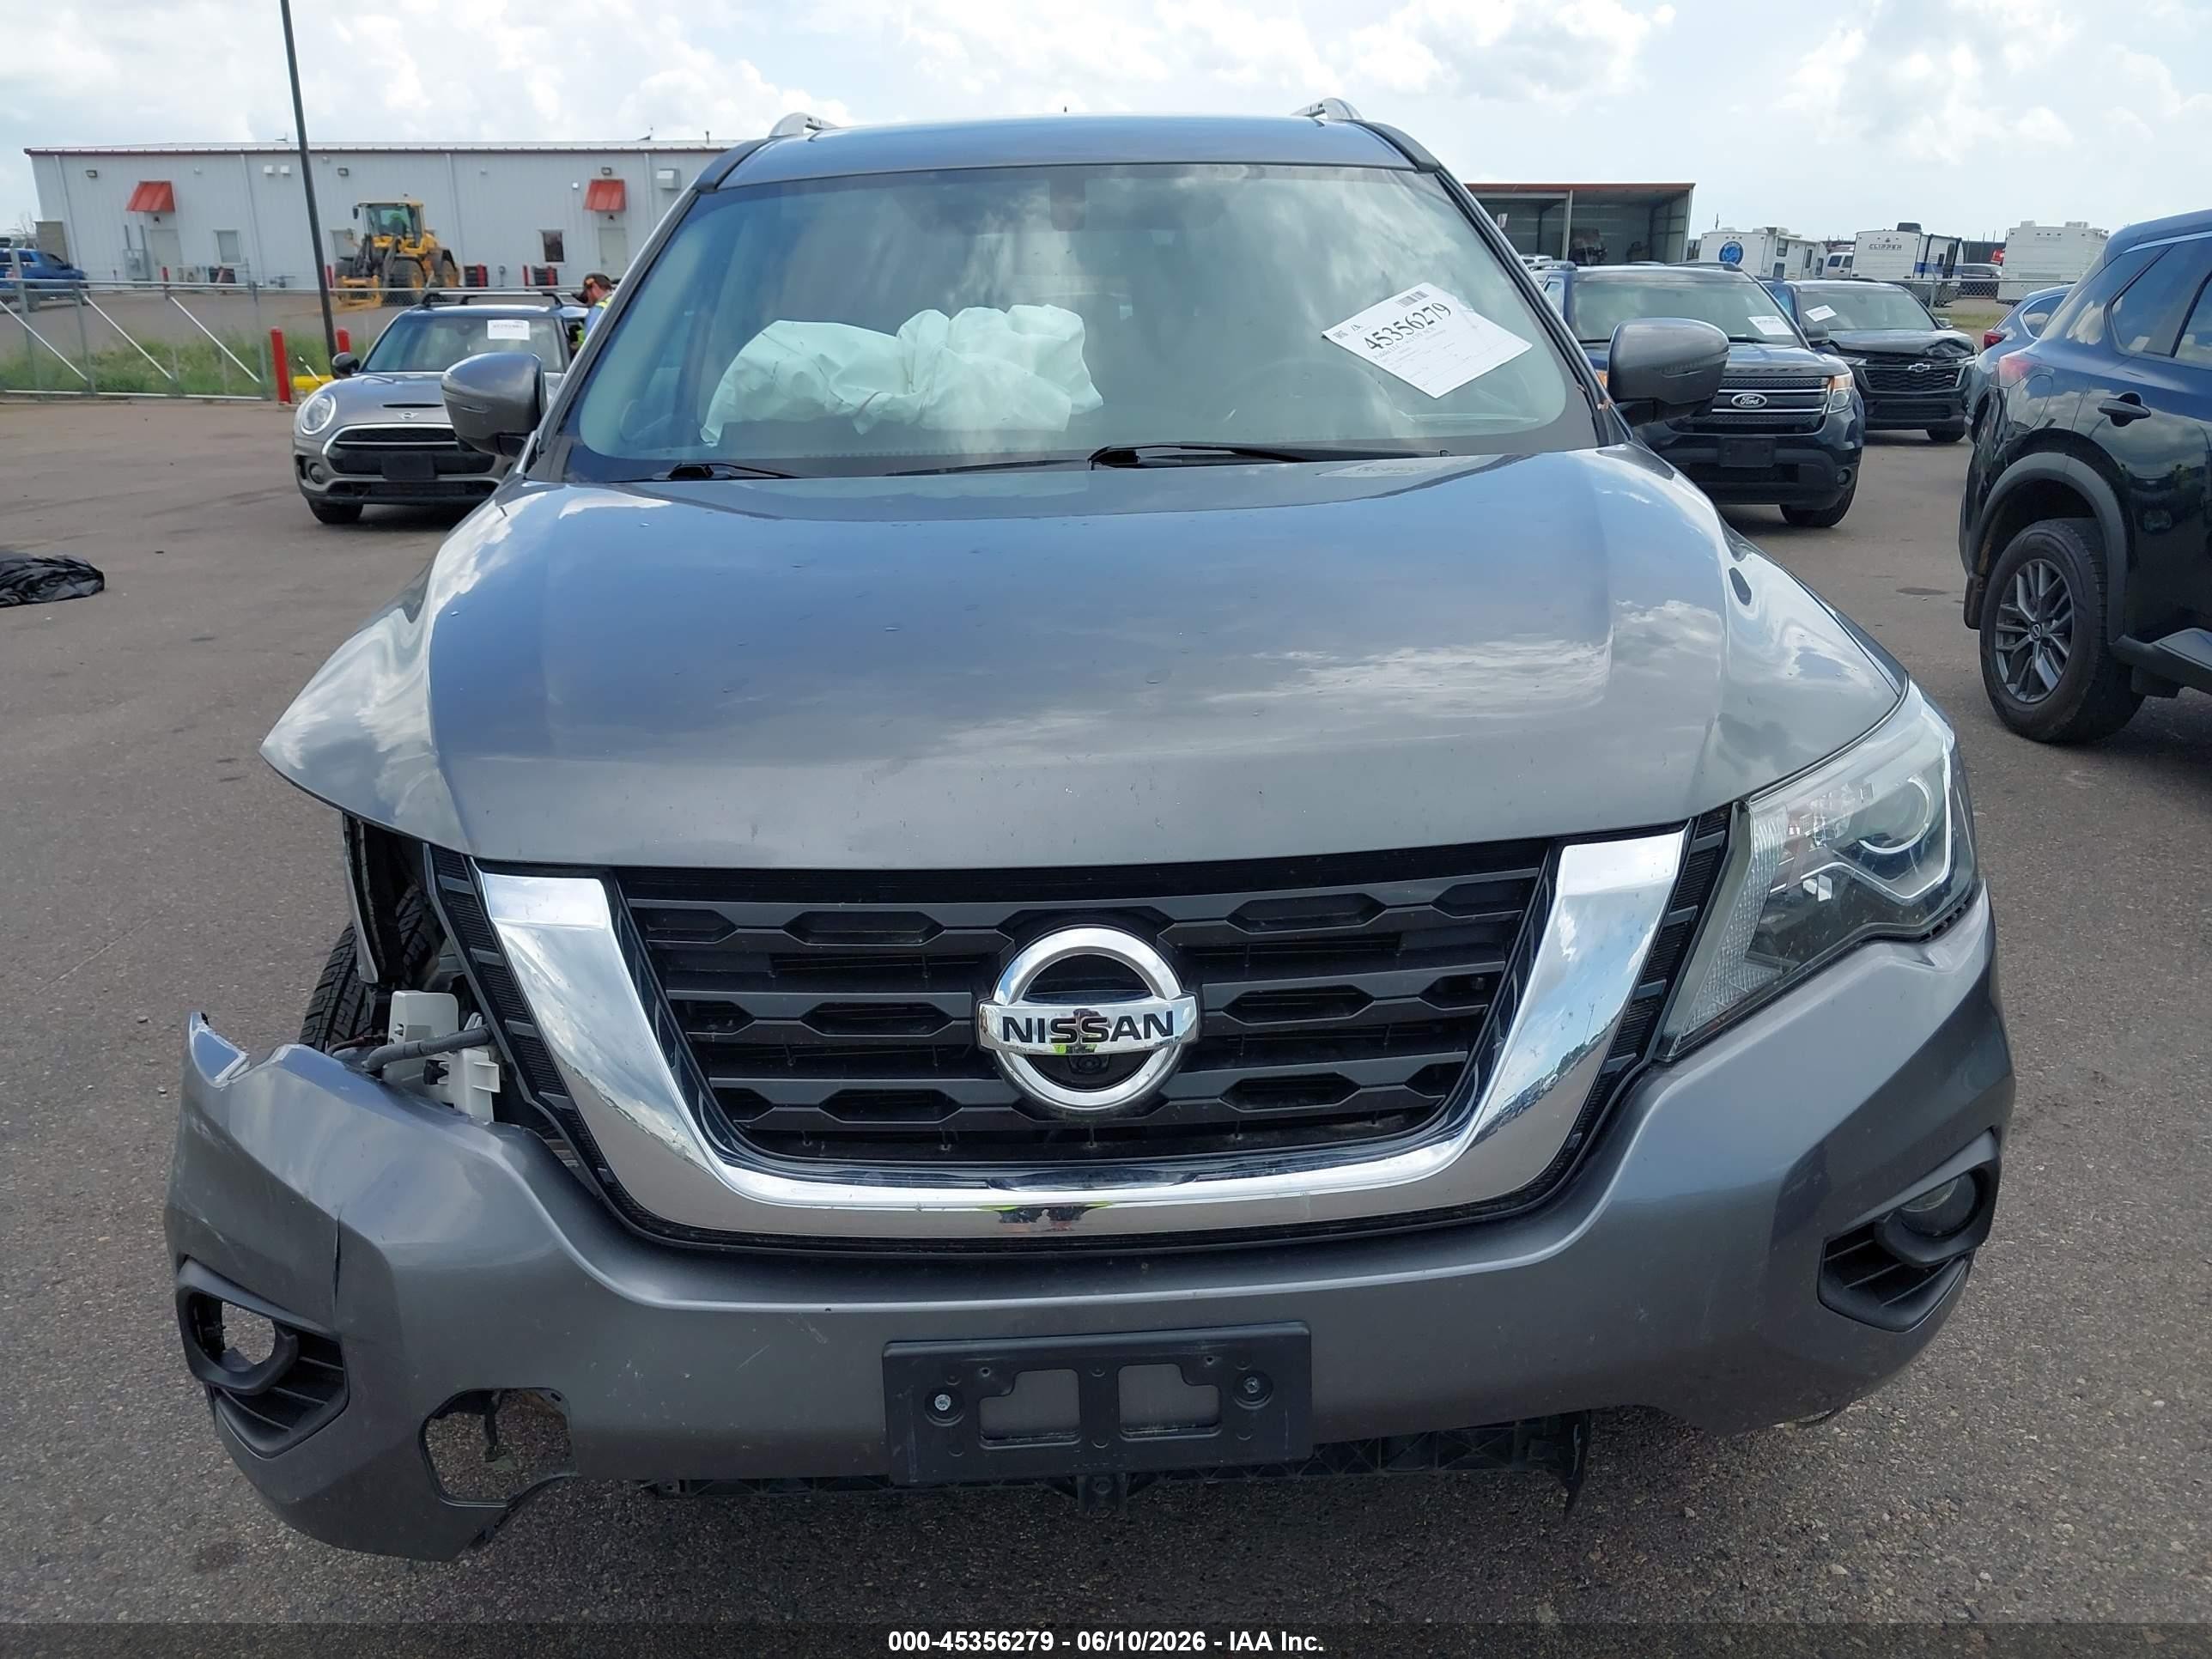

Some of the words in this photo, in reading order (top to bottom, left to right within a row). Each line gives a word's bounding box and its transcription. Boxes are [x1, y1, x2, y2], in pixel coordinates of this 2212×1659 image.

[1364, 302, 1451, 350] 45356279
[1740, 395, 1760, 405] Ford
[1002, 1010, 1175, 1044] NISSAN
